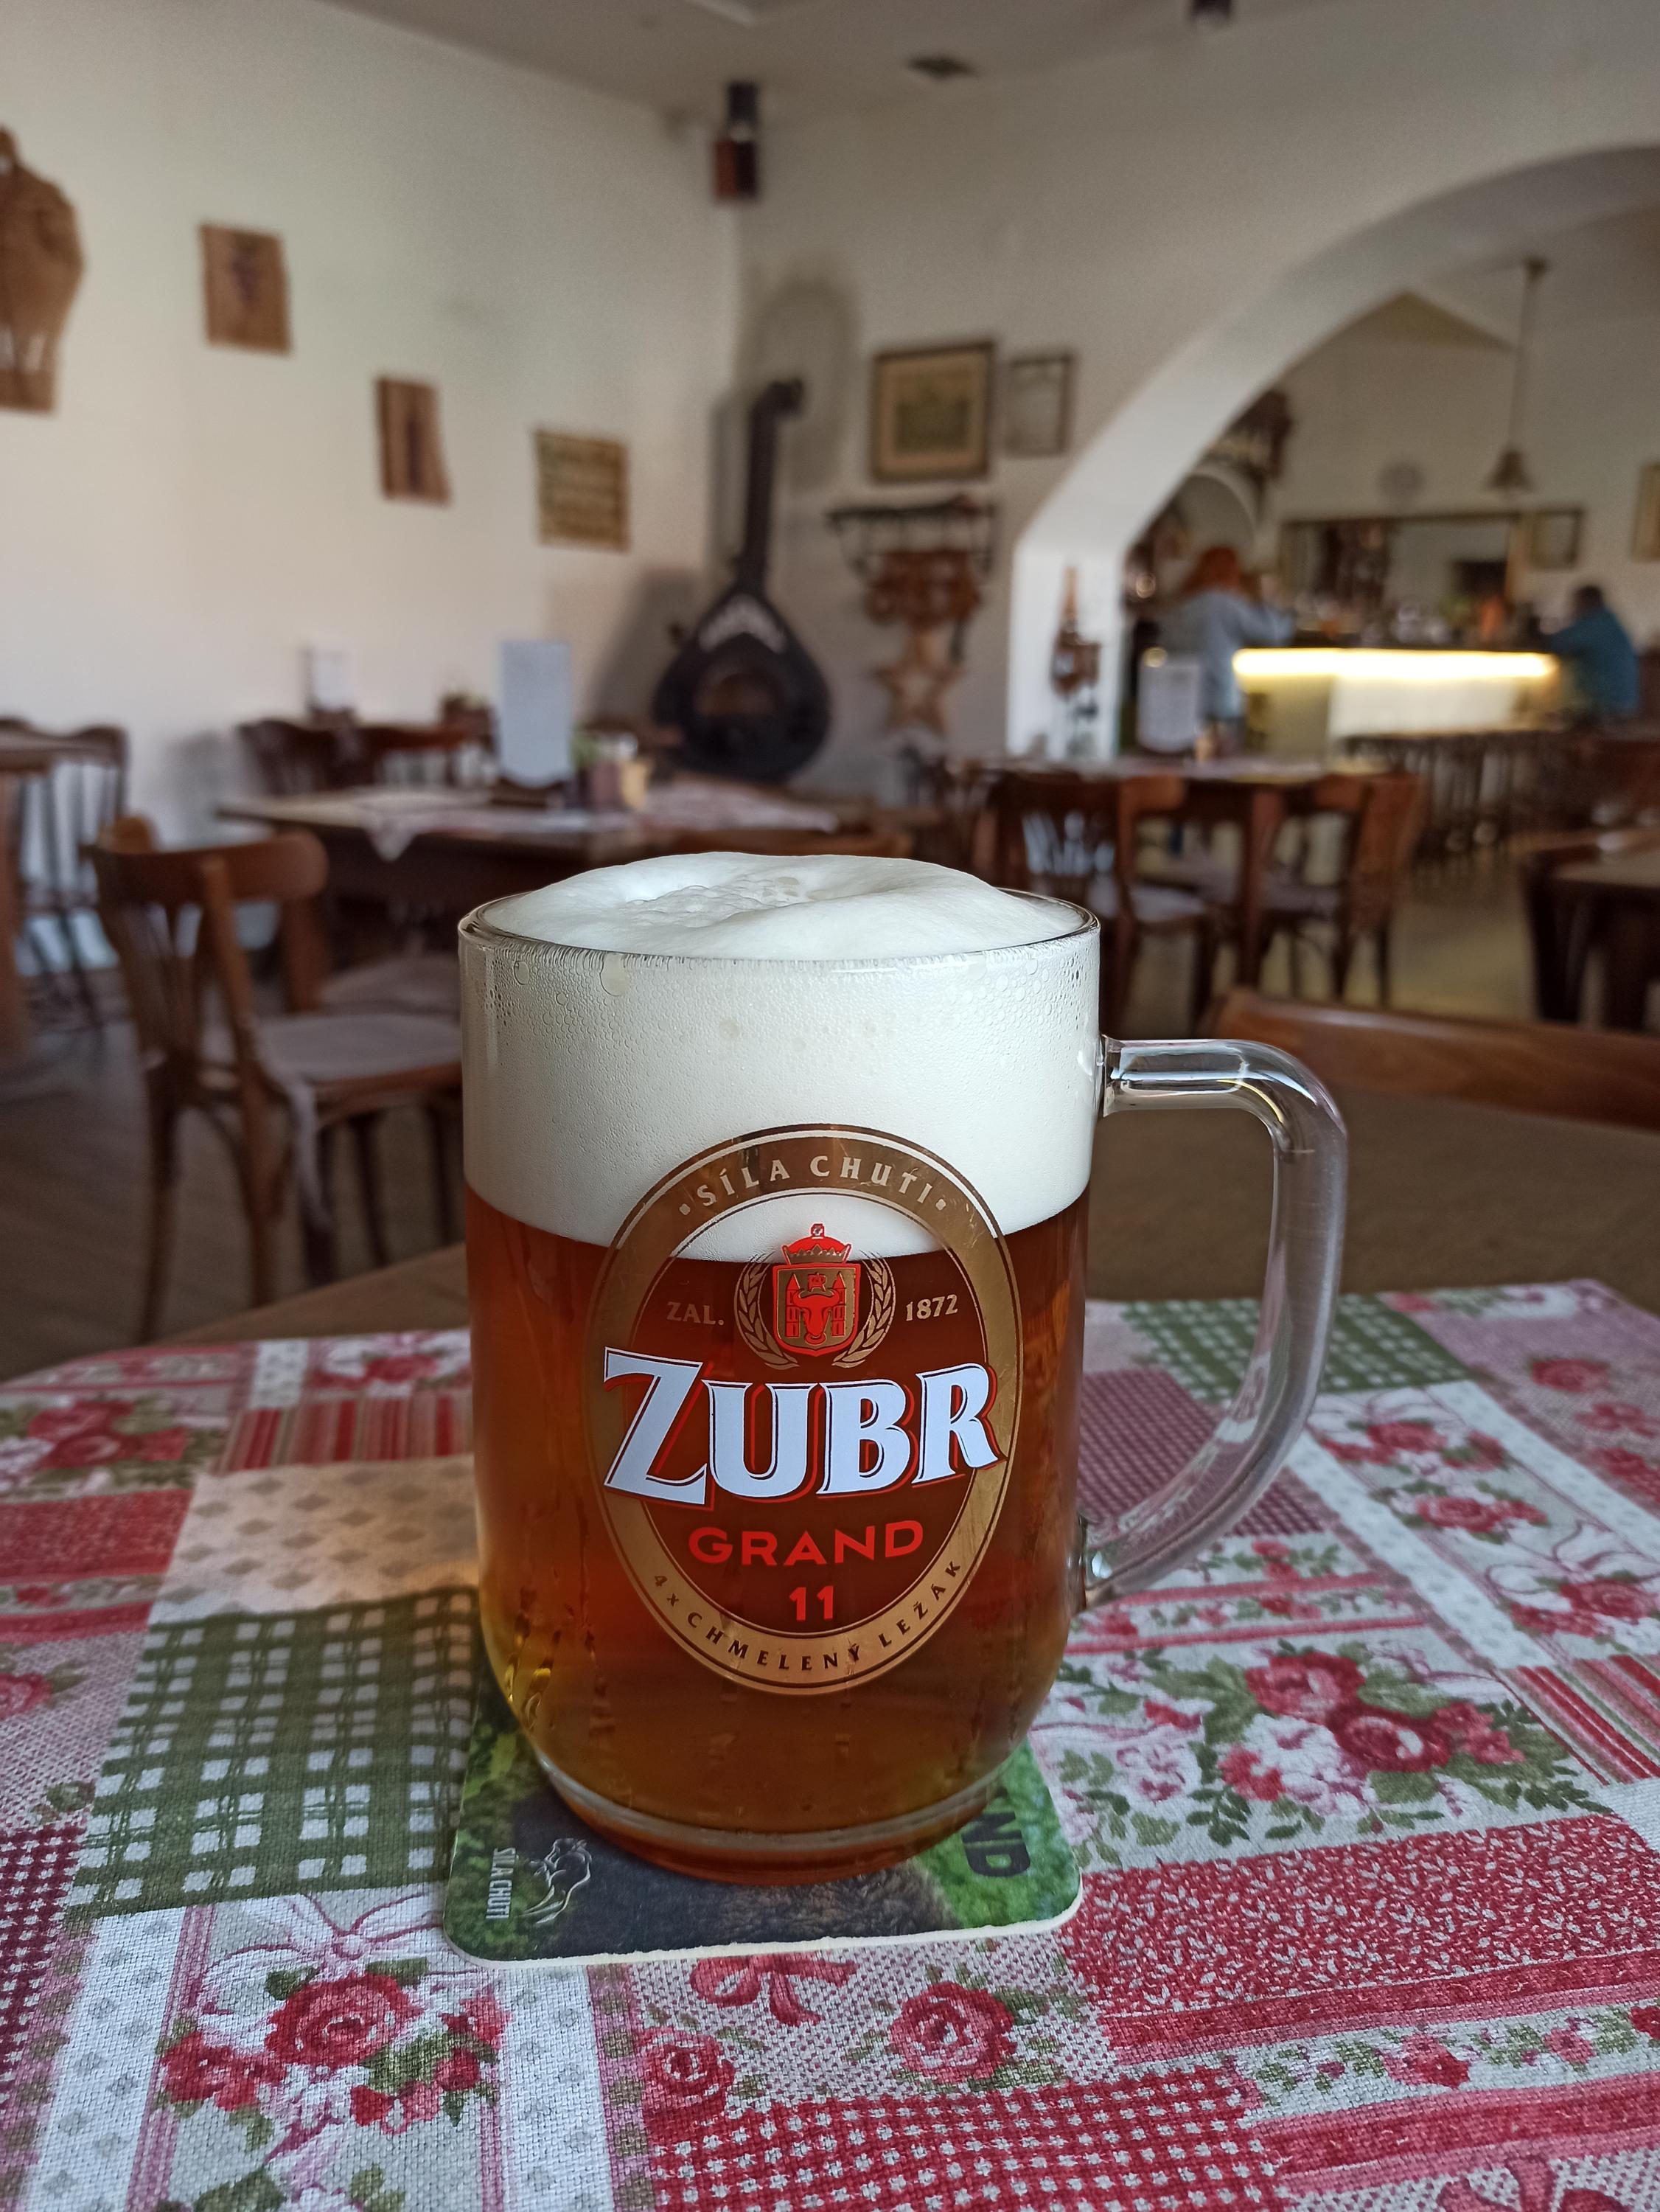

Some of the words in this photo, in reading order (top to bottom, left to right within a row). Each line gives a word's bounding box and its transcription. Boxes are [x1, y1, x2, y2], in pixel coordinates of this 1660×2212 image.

[697, 1160, 790, 1206] SÍLA
[810, 1155, 932, 1204] CHUTI
[667, 1301, 725, 1326] ZAL.
[906, 1294, 959, 1321] 1872
[603, 1346, 1004, 1510] ZUBR
[688, 1520, 924, 1566] GRAND
[687, 1612, 860, 1671] CHMELENÝ
[878, 1560, 960, 1648] LEŽÁK
[789, 1585, 834, 1621] 11
[490, 1847, 519, 1878] SÍLA
[486, 1879, 512, 1919] CHUTI
